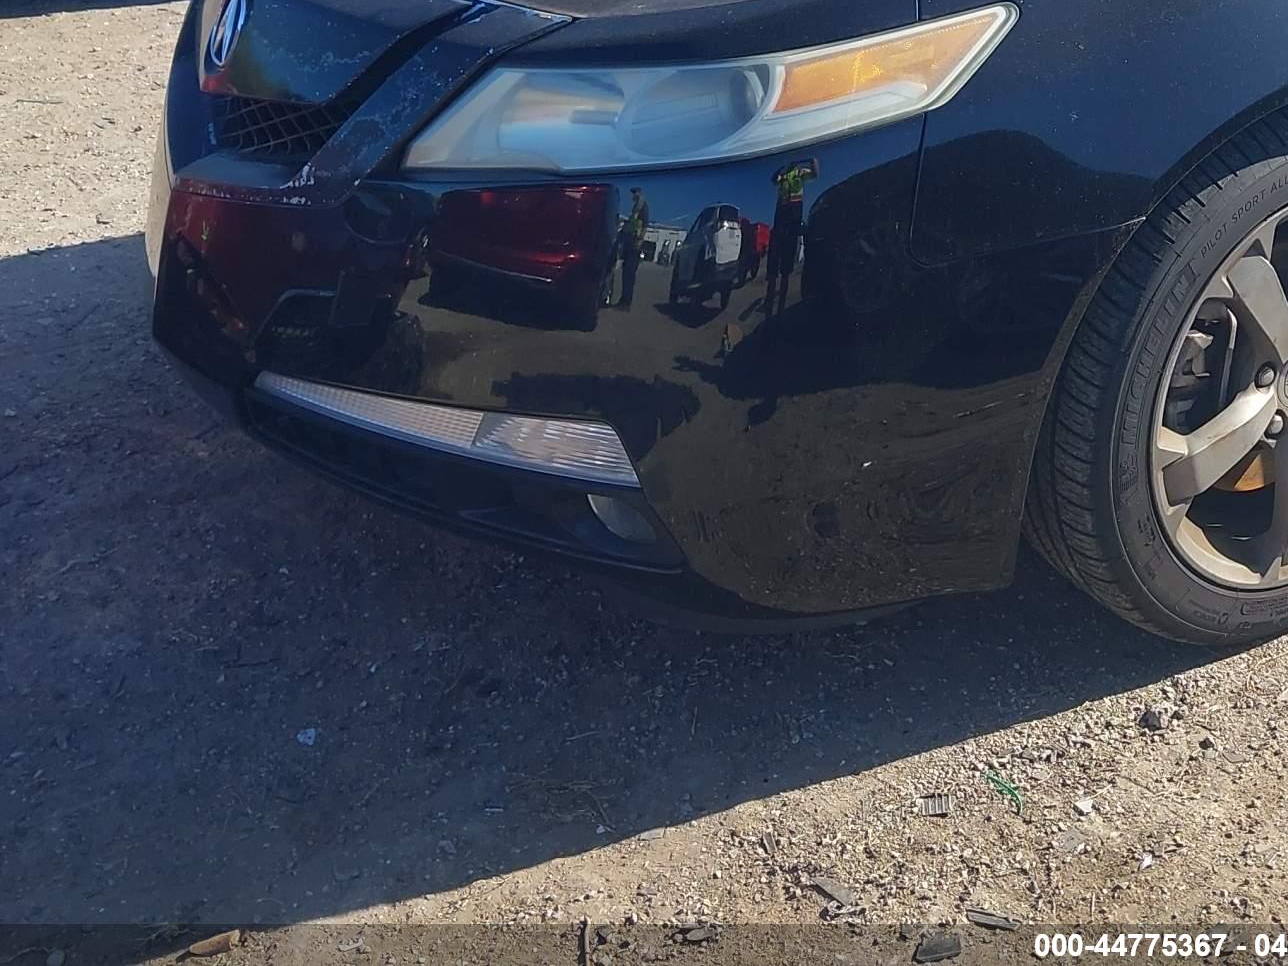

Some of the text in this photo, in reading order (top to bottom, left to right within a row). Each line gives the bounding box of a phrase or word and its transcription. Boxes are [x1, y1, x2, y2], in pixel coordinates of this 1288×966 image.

[1200, 224, 1229, 260] PILOT
[1231, 188, 1267, 223] SPORT
[1121, 272, 1189, 445] MICHELIN
